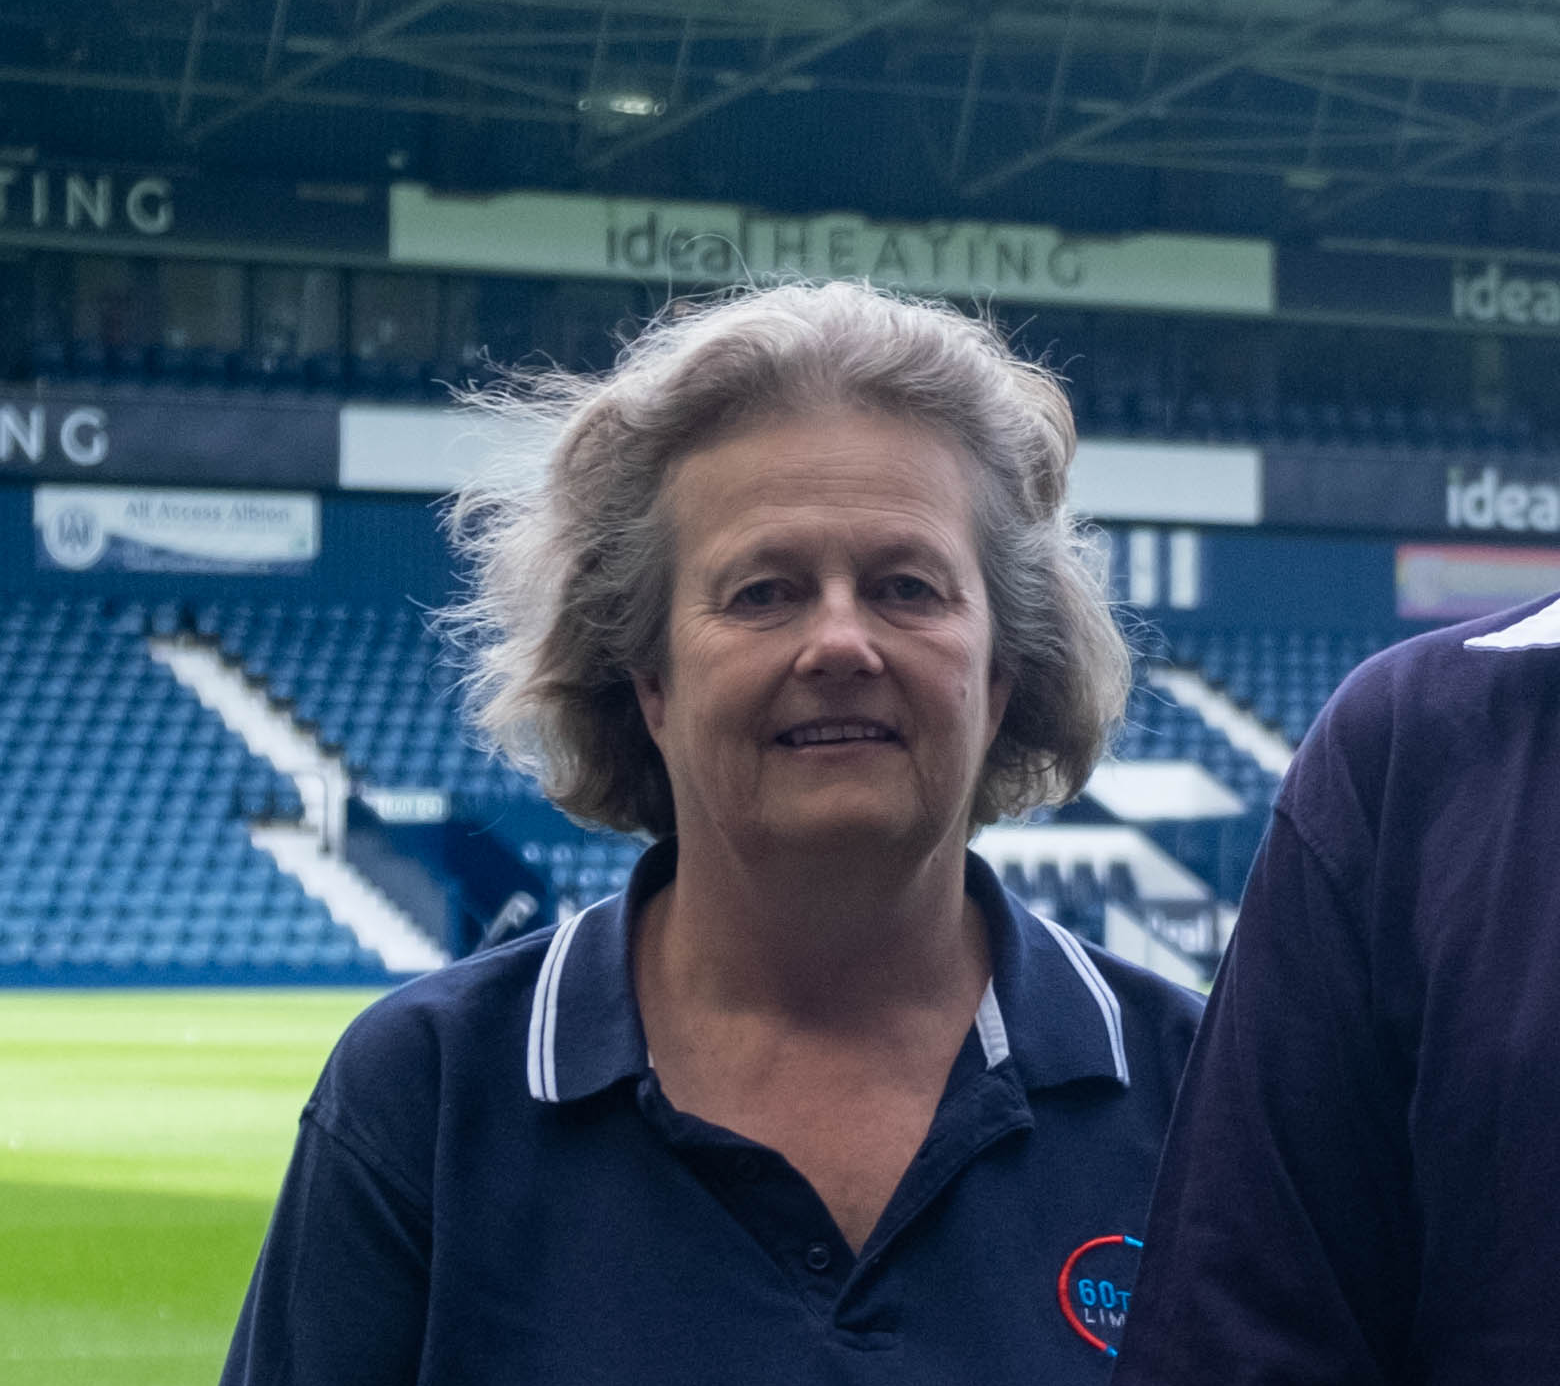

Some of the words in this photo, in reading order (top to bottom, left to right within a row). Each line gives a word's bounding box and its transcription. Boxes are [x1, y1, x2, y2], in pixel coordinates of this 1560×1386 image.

[605, 210, 751, 275] ideal
[772, 217, 1082, 289] HEATING
[157, 501, 222, 521] Access
[230, 501, 292, 522] Albion
